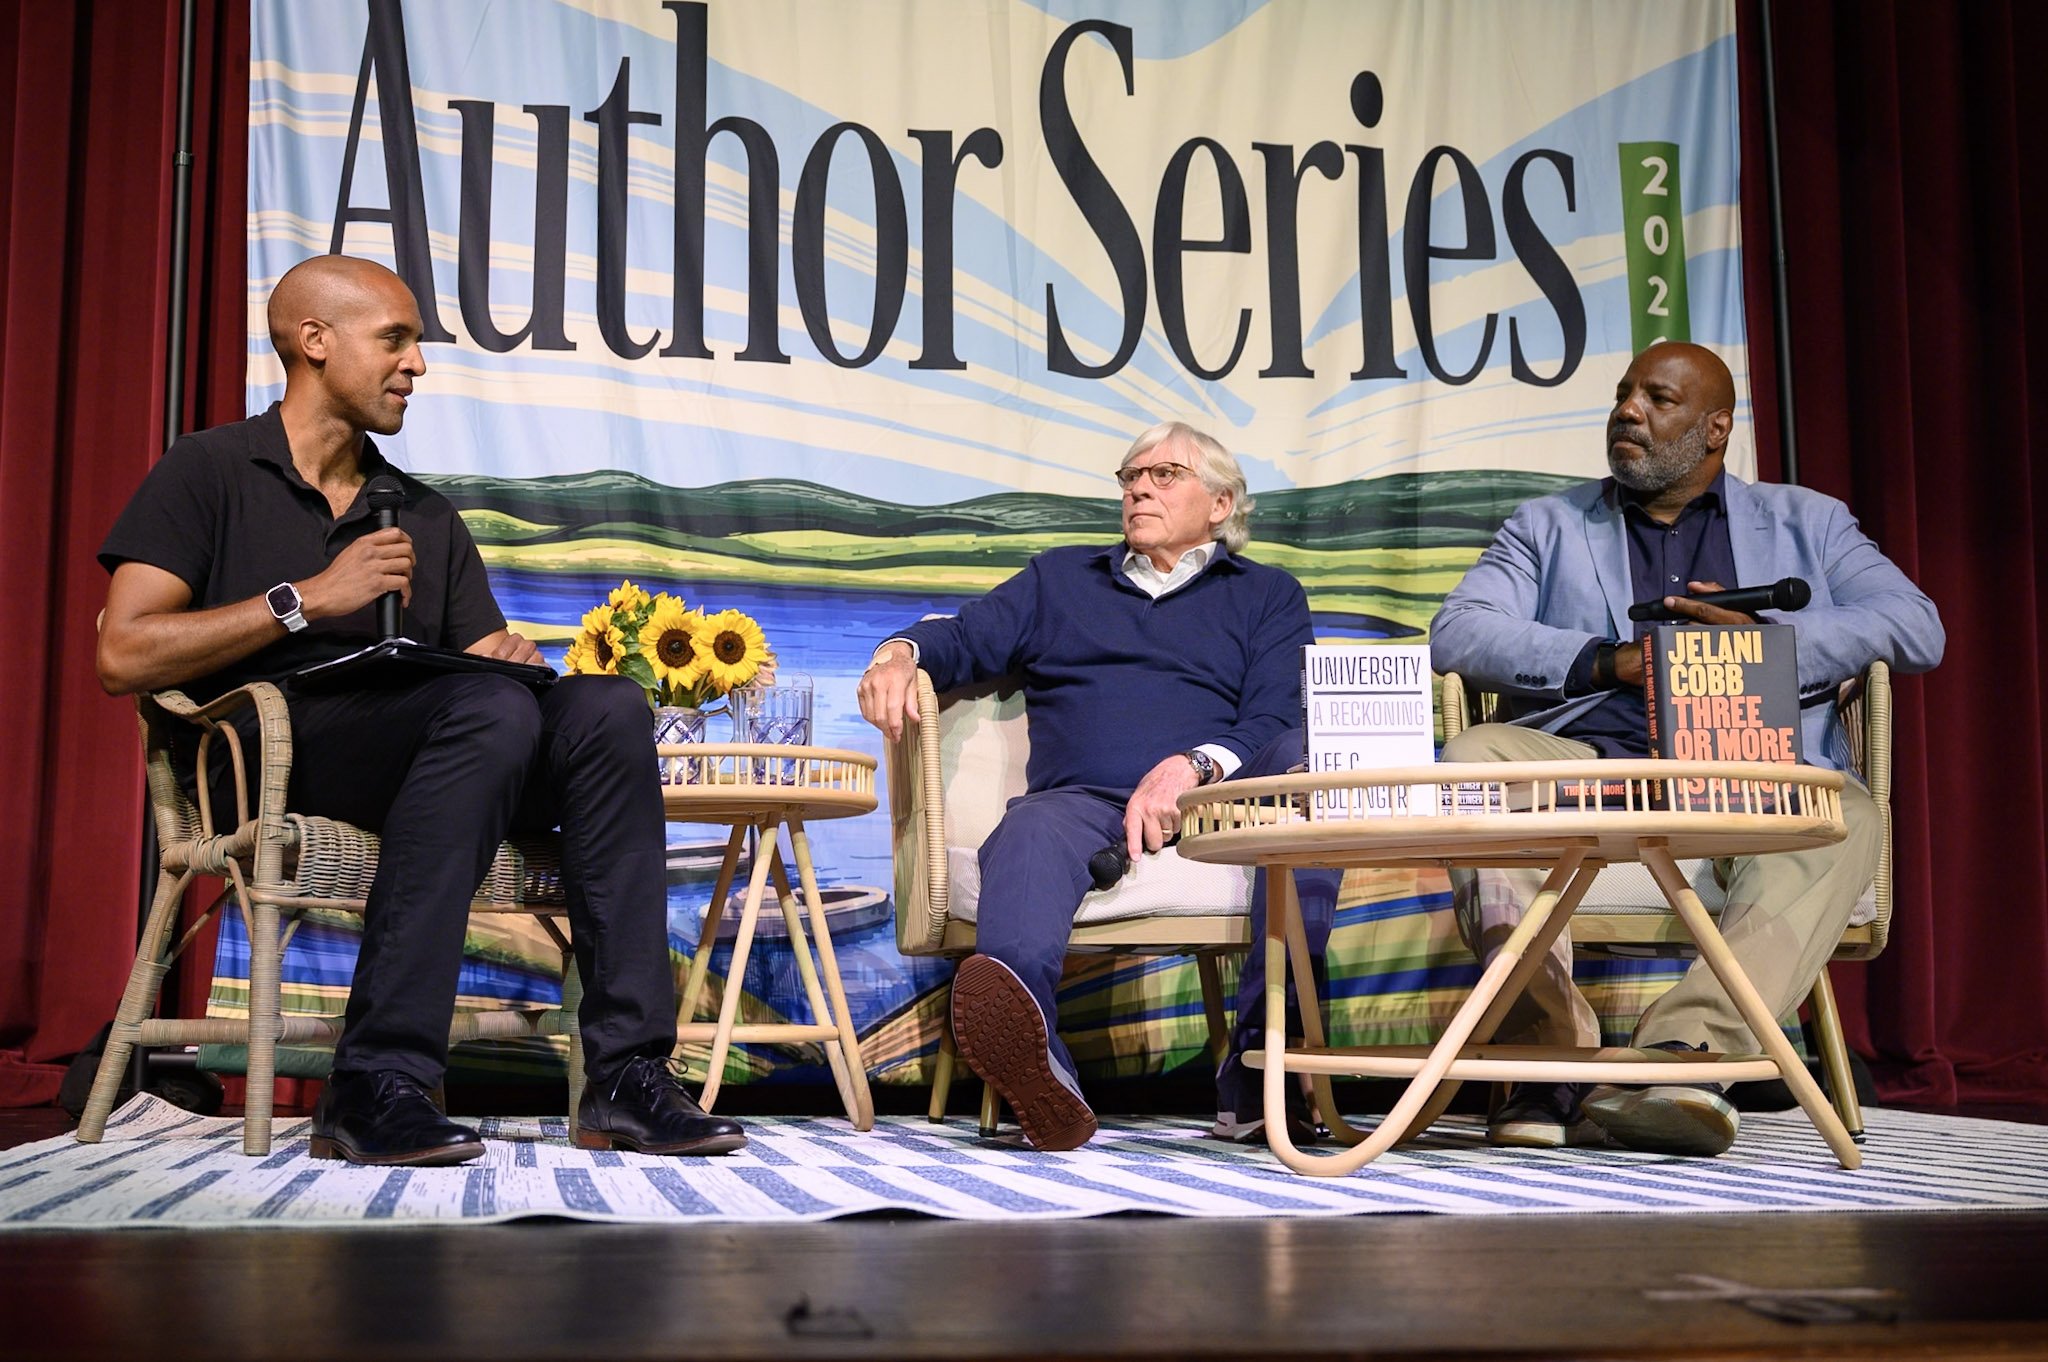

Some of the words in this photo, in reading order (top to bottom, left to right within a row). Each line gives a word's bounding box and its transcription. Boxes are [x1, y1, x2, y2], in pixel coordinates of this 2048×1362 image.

[329, 0, 1004, 370] Author
[1040, 19, 1587, 387] Series
[1641, 156, 1669, 346] 202
[1643, 634, 1653, 662] THREE
[1668, 631, 1763, 664] JELANI
[1312, 656, 1421, 685] UNIVERSITY
[1645, 663, 1654, 676] OR
[1670, 664, 1744, 696] COBB
[1646, 677, 1655, 700] MORE
[1313, 701, 1323, 726] A
[1330, 700, 1425, 726] RECKONING
[1648, 702, 1656, 712] IS
[1671, 696, 1764, 729] THREE
[1649, 719, 1658, 740] RIOT
[1674, 728, 1713, 761] OR
[1717, 728, 1796, 761] MORE
[1316, 784, 1408, 809] BOLINGR
[1453, 794, 1483, 805] LLINGER
[1563, 785, 1590, 796] THRE
[1602, 784, 1625, 796] MORE
